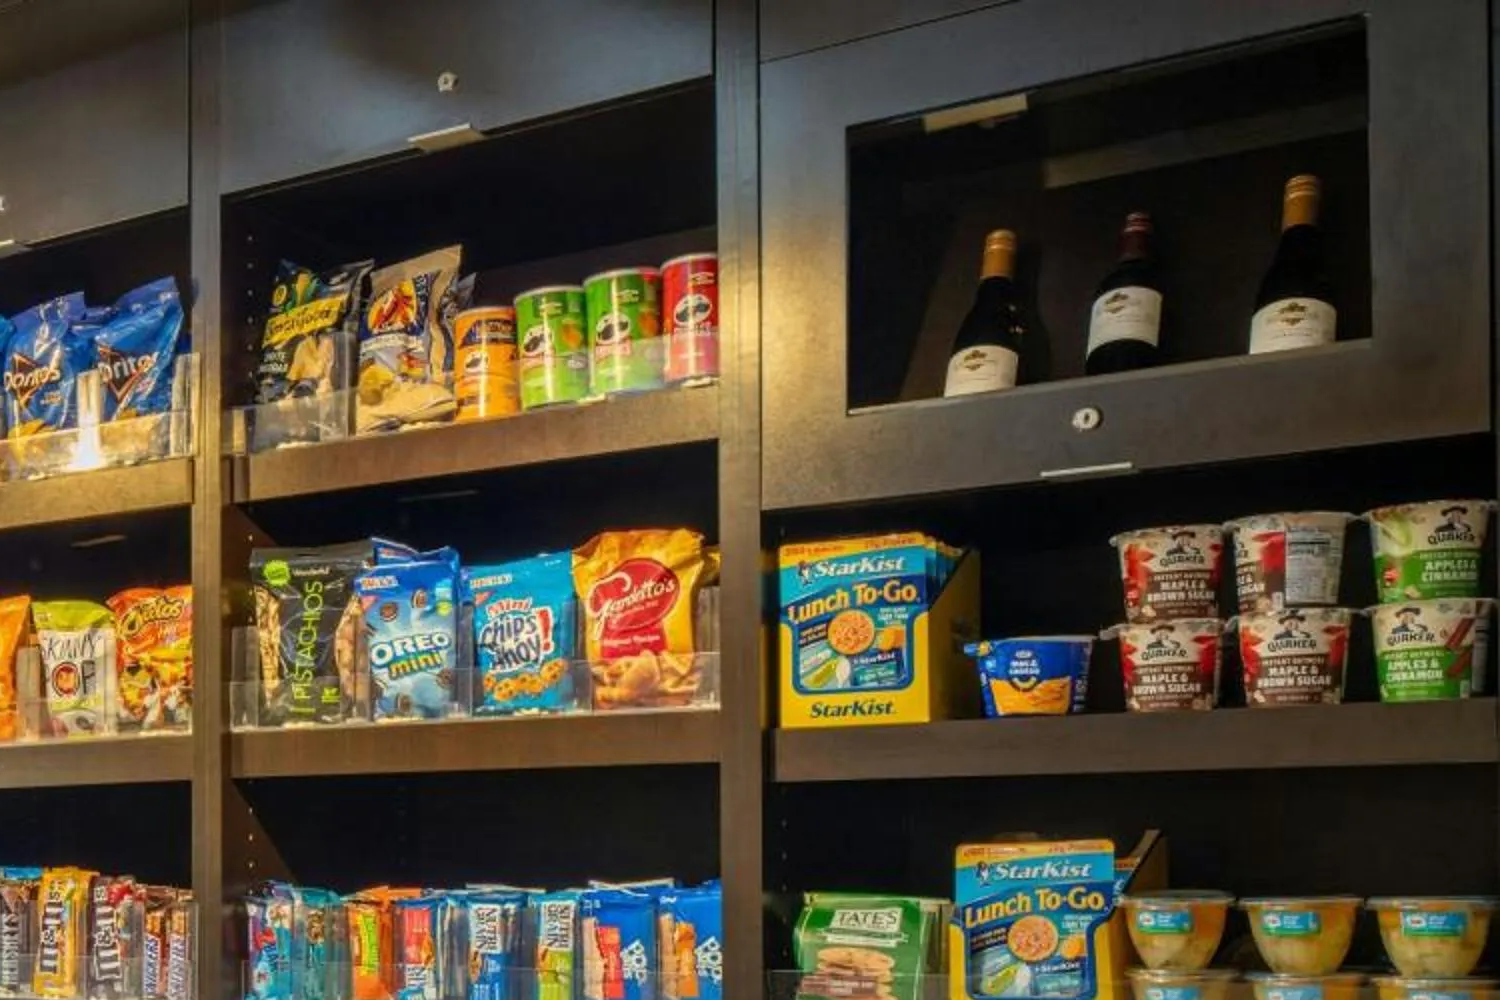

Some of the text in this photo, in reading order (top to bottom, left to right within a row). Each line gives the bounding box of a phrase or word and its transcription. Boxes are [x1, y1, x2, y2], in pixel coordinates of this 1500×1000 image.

[815, 555, 905, 577] StarKist
[787, 588, 851, 625] Lunch
[479, 611, 538, 650] Chips
[371, 631, 450, 667] OREO
[810, 698, 894, 719] StarKist
[994, 859, 1092, 880] StarKist
[964, 891, 1032, 929] Lunch
